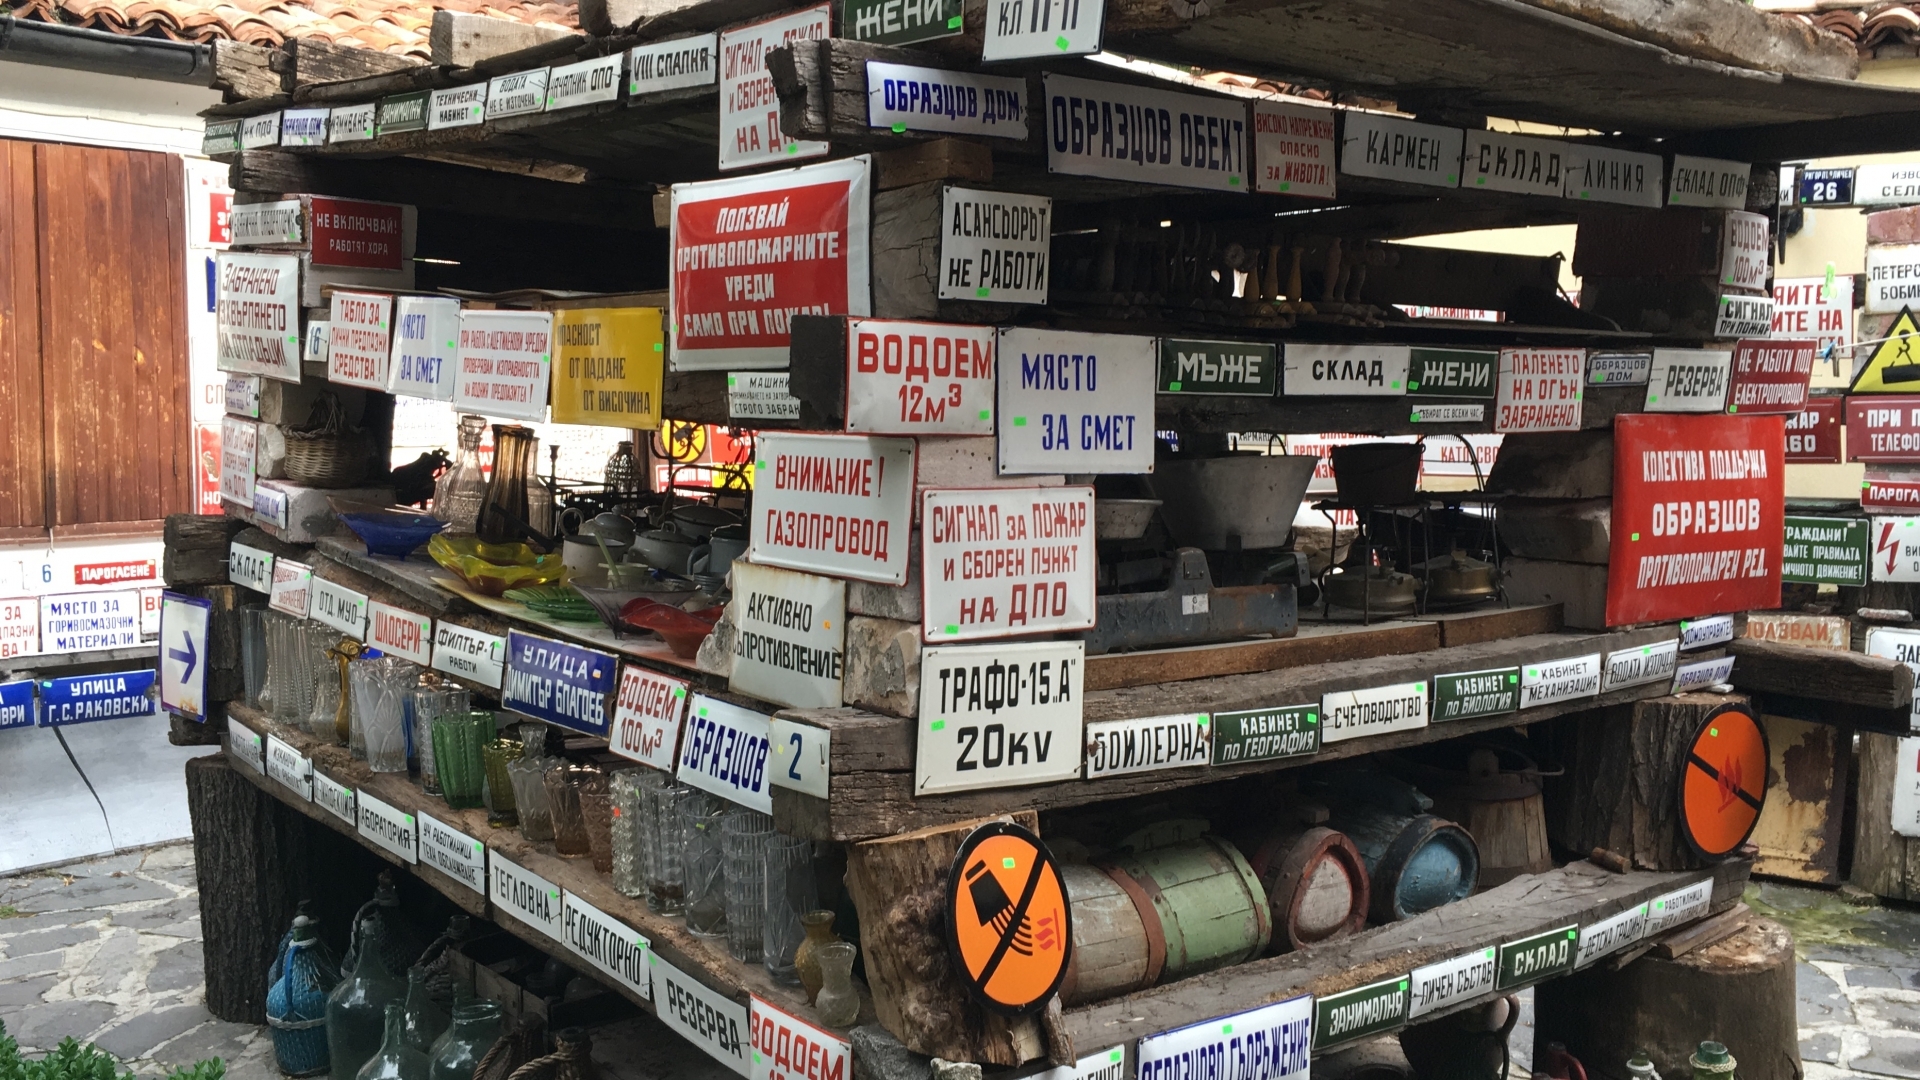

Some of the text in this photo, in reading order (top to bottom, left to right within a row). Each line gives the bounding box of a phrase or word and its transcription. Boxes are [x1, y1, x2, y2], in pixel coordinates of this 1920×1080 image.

[856, 0, 942, 40] ЖЕНИ
[658, 47, 709, 77] СПАЛНЯ
[726, 38, 762, 80] СИГНАЛ
[500, 76, 528, 93] ВОДАТА
[590, 66, 613, 90] ОПО
[436, 89, 478, 107] ТЕХНИЧЕСКИ
[489, 100, 498, 113] НЕ
[737, 76, 775, 111] СБОРЕН
[884, 78, 1020, 126] ОБРАЗЦОВ ДОМ
[440, 107, 469, 123] КАБИНЕТ
[1256, 112, 1334, 142] ВИСОКО НАПРЕЖЕНИЕ
[737, 125, 760, 153] НА
[1052, 95, 1243, 173] ОБРАЗЦОВ ОБЕКТ
[1280, 140, 1320, 159] ОПАСНО
[1366, 129, 1441, 172] КАРМЕН
[1266, 161, 1330, 186] ЗА ЖИВОТА!
[1478, 143, 1560, 188] СКЛАД
[1584, 157, 1645, 193] ЛИНИЯ
[1675, 167, 1746, 198] СКЛАД ОПФ
[1812, 182, 1838, 202] 26
[316, 213, 330, 228] НЕ
[333, 212, 398, 235] ВКЛЮЧВАЙ!
[716, 196, 790, 234] ПОЛЗВАЙ
[952, 202, 1046, 242] АСАНСЬОРЪТ
[330, 238, 389, 256] РАБОТЯТ ХОРА
[1731, 220, 1769, 252] ВОДОЕМ
[678, 232, 838, 272] ПРОТИВОПОЖАРНИТЕ
[222, 262, 280, 296] ЗАБРАНЕНО
[948, 248, 1045, 290] НЕ РАБОТИ
[725, 274, 775, 302] УРЕДИ
[340, 300, 380, 326] ТАБЛО ЗА
[684, 310, 760, 337] САМО ПРИ
[1726, 300, 1773, 321] СИГНАЛ
[1818, 310, 1844, 331] НА
[309, 326, 320, 354] 16
[330, 326, 387, 354] ЛИЧНИ ПРЕДПАЗНИ
[400, 314, 426, 340] МЯСТО
[557, 323, 602, 346] ОПАСНОСТ
[1719, 320, 1770, 336] ПРИ ПОЖАР
[460, 330, 470, 349] ПРИ
[470, 330, 486, 349] РАБОТА
[525, 332, 548, 354] УРЕДБИ
[401, 354, 443, 384] ЗА СМЕТ
[462, 358, 540, 379] ПРОВЕРЯВАЙ ИЗПРАВНОСТТА
[570, 358, 626, 382] ОТ ПАДАНЕ
[858, 332, 992, 382] ВОДОЕМ
[1176, 352, 1262, 384] МЪЖЕ
[1512, 353, 1580, 375] ПАЛЕНЕТО
[1594, 358, 1646, 370] ОБРАЗЦОВ
[1738, 348, 1813, 374] НЕ РАБОТИ ПОД
[1022, 352, 1096, 391] МЯСТО
[1312, 358, 1384, 387] СКЛАД
[1422, 360, 1490, 388] ЖЕНИ
[1606, 372, 1632, 382] ДОМ
[1664, 364, 1724, 398] РЕЗЕРВА
[584, 390, 650, 414] ОТ ВИСОЧИНА
[1512, 379, 1578, 400] НА ОГЪН
[734, 404, 800, 415] СТРОГО ЗАБРАН
[1443, 408, 1450, 420] СЕ
[1451, 407, 1468, 420] ВСЕКИ
[1469, 408, 1480, 418] ЧАС
[1500, 401, 1580, 429] ЗАБРАНЕНО!
[1868, 409, 1902, 428] ПРИ
[1042, 414, 1136, 451] ЗА СМЕТ
[1441, 446, 1470, 463] КАТО
[1643, 449, 1768, 482] КОЛЕКТИВА ПОДДЪРЖА
[932, 502, 1086, 544] СИГНАЛ ПОЖАР
[1652, 498, 1760, 537] ОБРАЗЦОВ
[766, 508, 889, 562] ГАЗОПРОВОД
[962, 545, 1078, 580] СБОРЕН ПУНКТ
[1812, 545, 1860, 562] ПРАВИЛАТА
[42, 564, 52, 583] 6
[82, 564, 150, 582] ПАРОГАСЕНЕ
[230, 552, 264, 586] СКЛАД
[1636, 548, 1768, 589] ПРОТИВОПОЖАРЕН РЕД.
[1816, 564, 1863, 580] ДВИЖЕНИЕ!
[4, 606, 22, 620] ЗА
[50, 600, 120, 616] МЯСТО ЗА
[338, 598, 357, 624] МУО
[747, 592, 812, 633] АКТИВНО
[960, 581, 1068, 627] НА ДПО
[48, 616, 134, 634] ГОРИВОСМАЗОЧНИ
[375, 610, 420, 654] ШЛОСЕРИ
[56, 632, 134, 650] МАТЕРИАЛИ
[450, 656, 477, 674] РАБОТИ
[523, 644, 588, 680] УЛИЦА
[732, 630, 842, 681] СЪПРОТИВЛЕНИЕ
[1455, 674, 1504, 696] КАБИНЕТ
[1541, 662, 1588, 680] КАБИНЕТ
[1610, 658, 1641, 684] ВОДАТА
[70, 678, 126, 696] УЛИЦА
[504, 664, 551, 710] ДИМИТЪР
[618, 674, 678, 722] ВОДОЕМ
[1529, 674, 1598, 702] МЕХАНИЗАЦИЯ
[1334, 695, 1421, 730] СЧЕТОВОДСТВО
[1461, 692, 1512, 715] БИОЛОГИЯ
[1240, 713, 1300, 736] КАБИНЕТ
[683, 715, 770, 792] ОБРАЗЦОВ
[788, 732, 802, 782] 2
[1094, 723, 1206, 772] БОЙЛЕРНА
[1242, 730, 1314, 758] ГЕОГРАФИЯ
[358, 804, 410, 850] ЛАБОРАТОРИЯ
[432, 824, 472, 860] РАБОТИЛНИЦА
[494, 864, 552, 924] ТЕГЛОВНА
[566, 904, 642, 986] РЕДУКТОРНО
[1584, 913, 1644, 960] ДЕТСКА ГРАДИНА
[1514, 940, 1568, 977] СКЛАД
[1420, 961, 1493, 1006] ЛИЧЕН СЪСТАВ
[666, 978, 743, 1060] РЕЗЕРВА
[1328, 990, 1402, 1038] ЗАНИМАЛНЯ
[751, 1009, 844, 1080] ВОДОЕМ
[1228, 1016, 1310, 1080] СЪОРЪЖЕНИЕ
